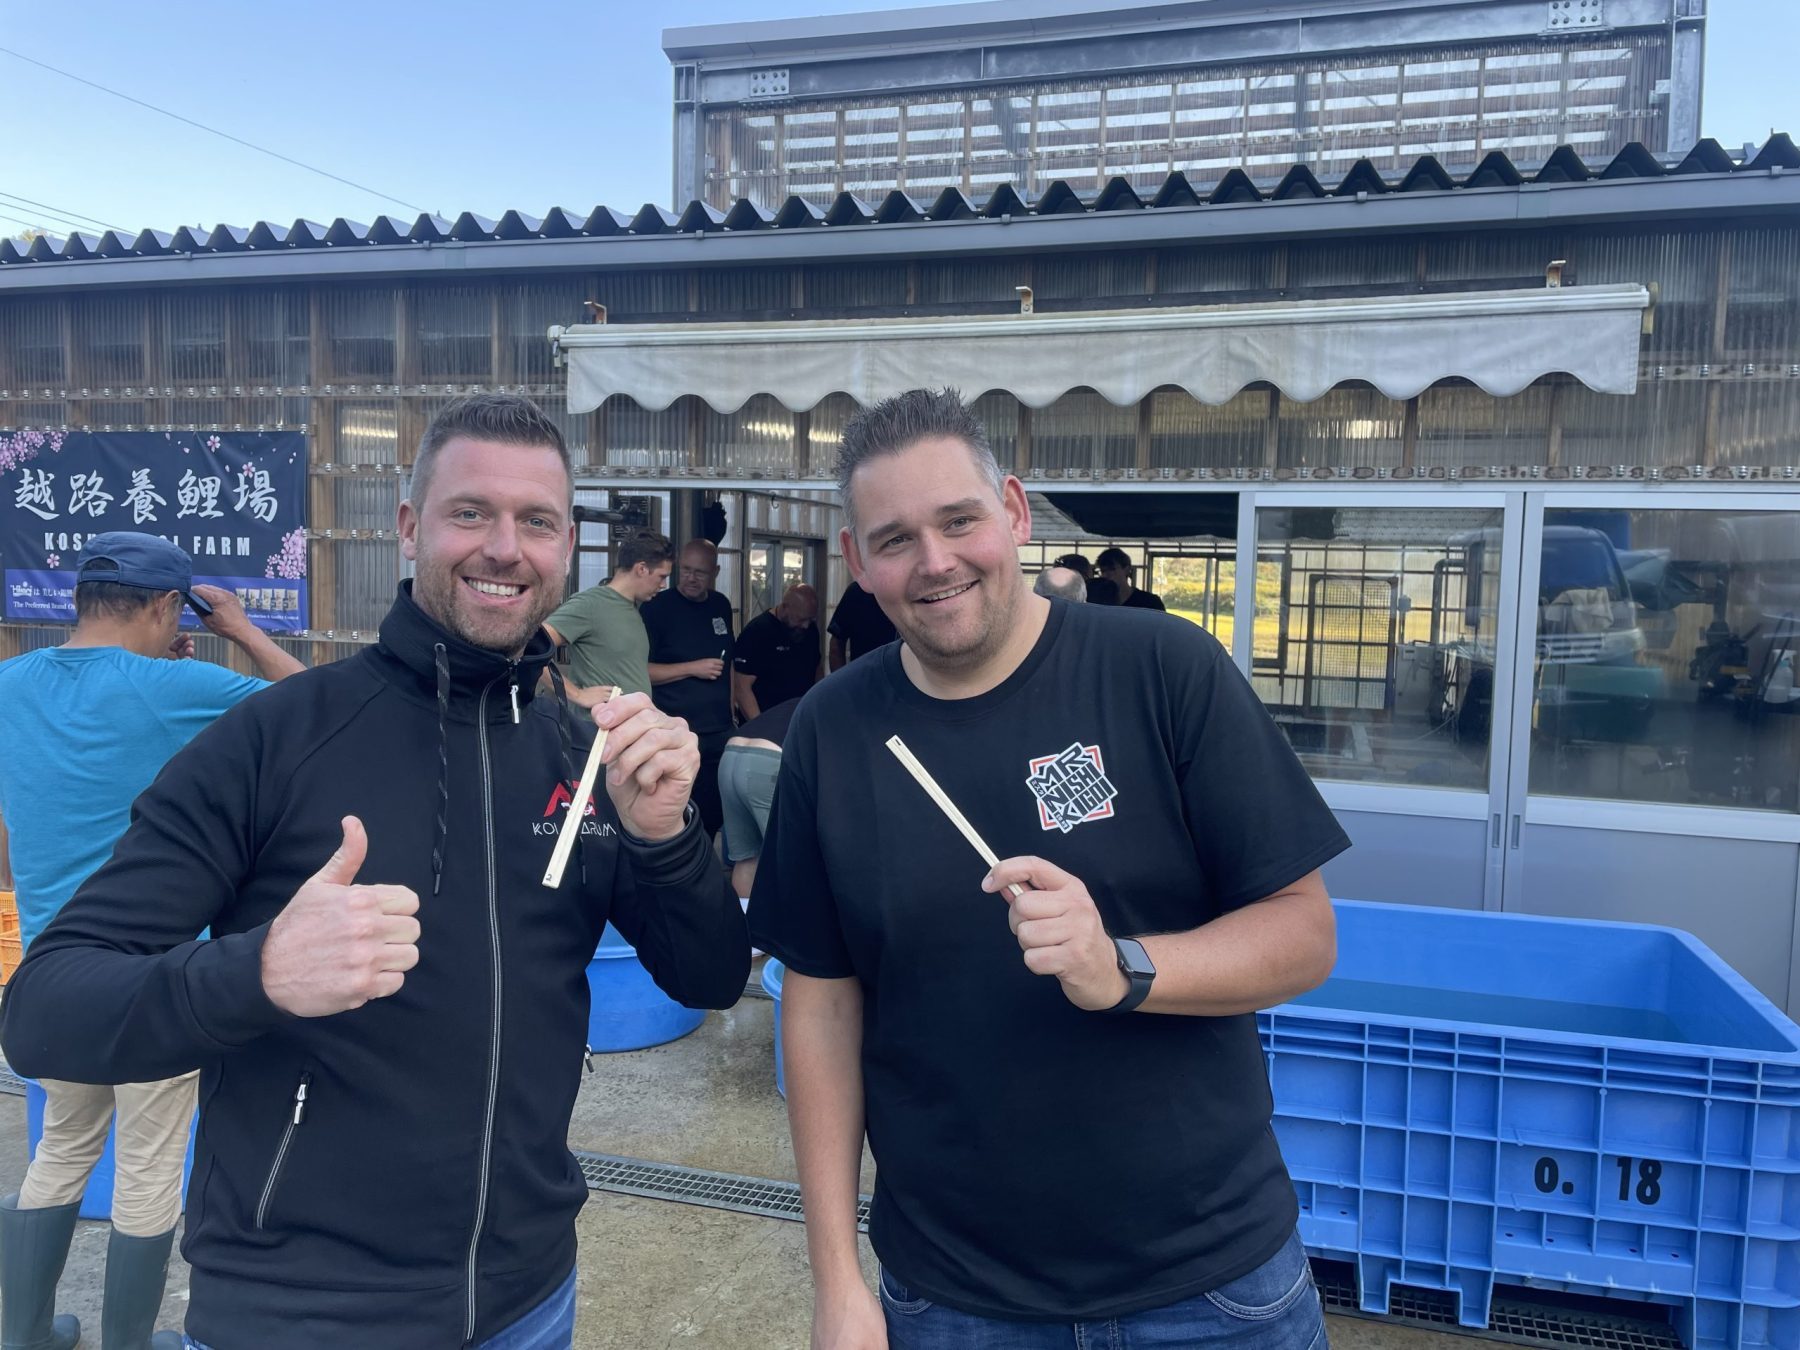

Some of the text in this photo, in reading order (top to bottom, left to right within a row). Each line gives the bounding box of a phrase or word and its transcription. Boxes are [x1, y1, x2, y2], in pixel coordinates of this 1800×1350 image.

[14, 467, 278, 524] 越路養鯉場
[193, 536, 250, 556] FARM
[1028, 745, 1090, 796] MR
[1041, 761, 1103, 812] NISHI
[1534, 1156, 1662, 1205] 0. 18
